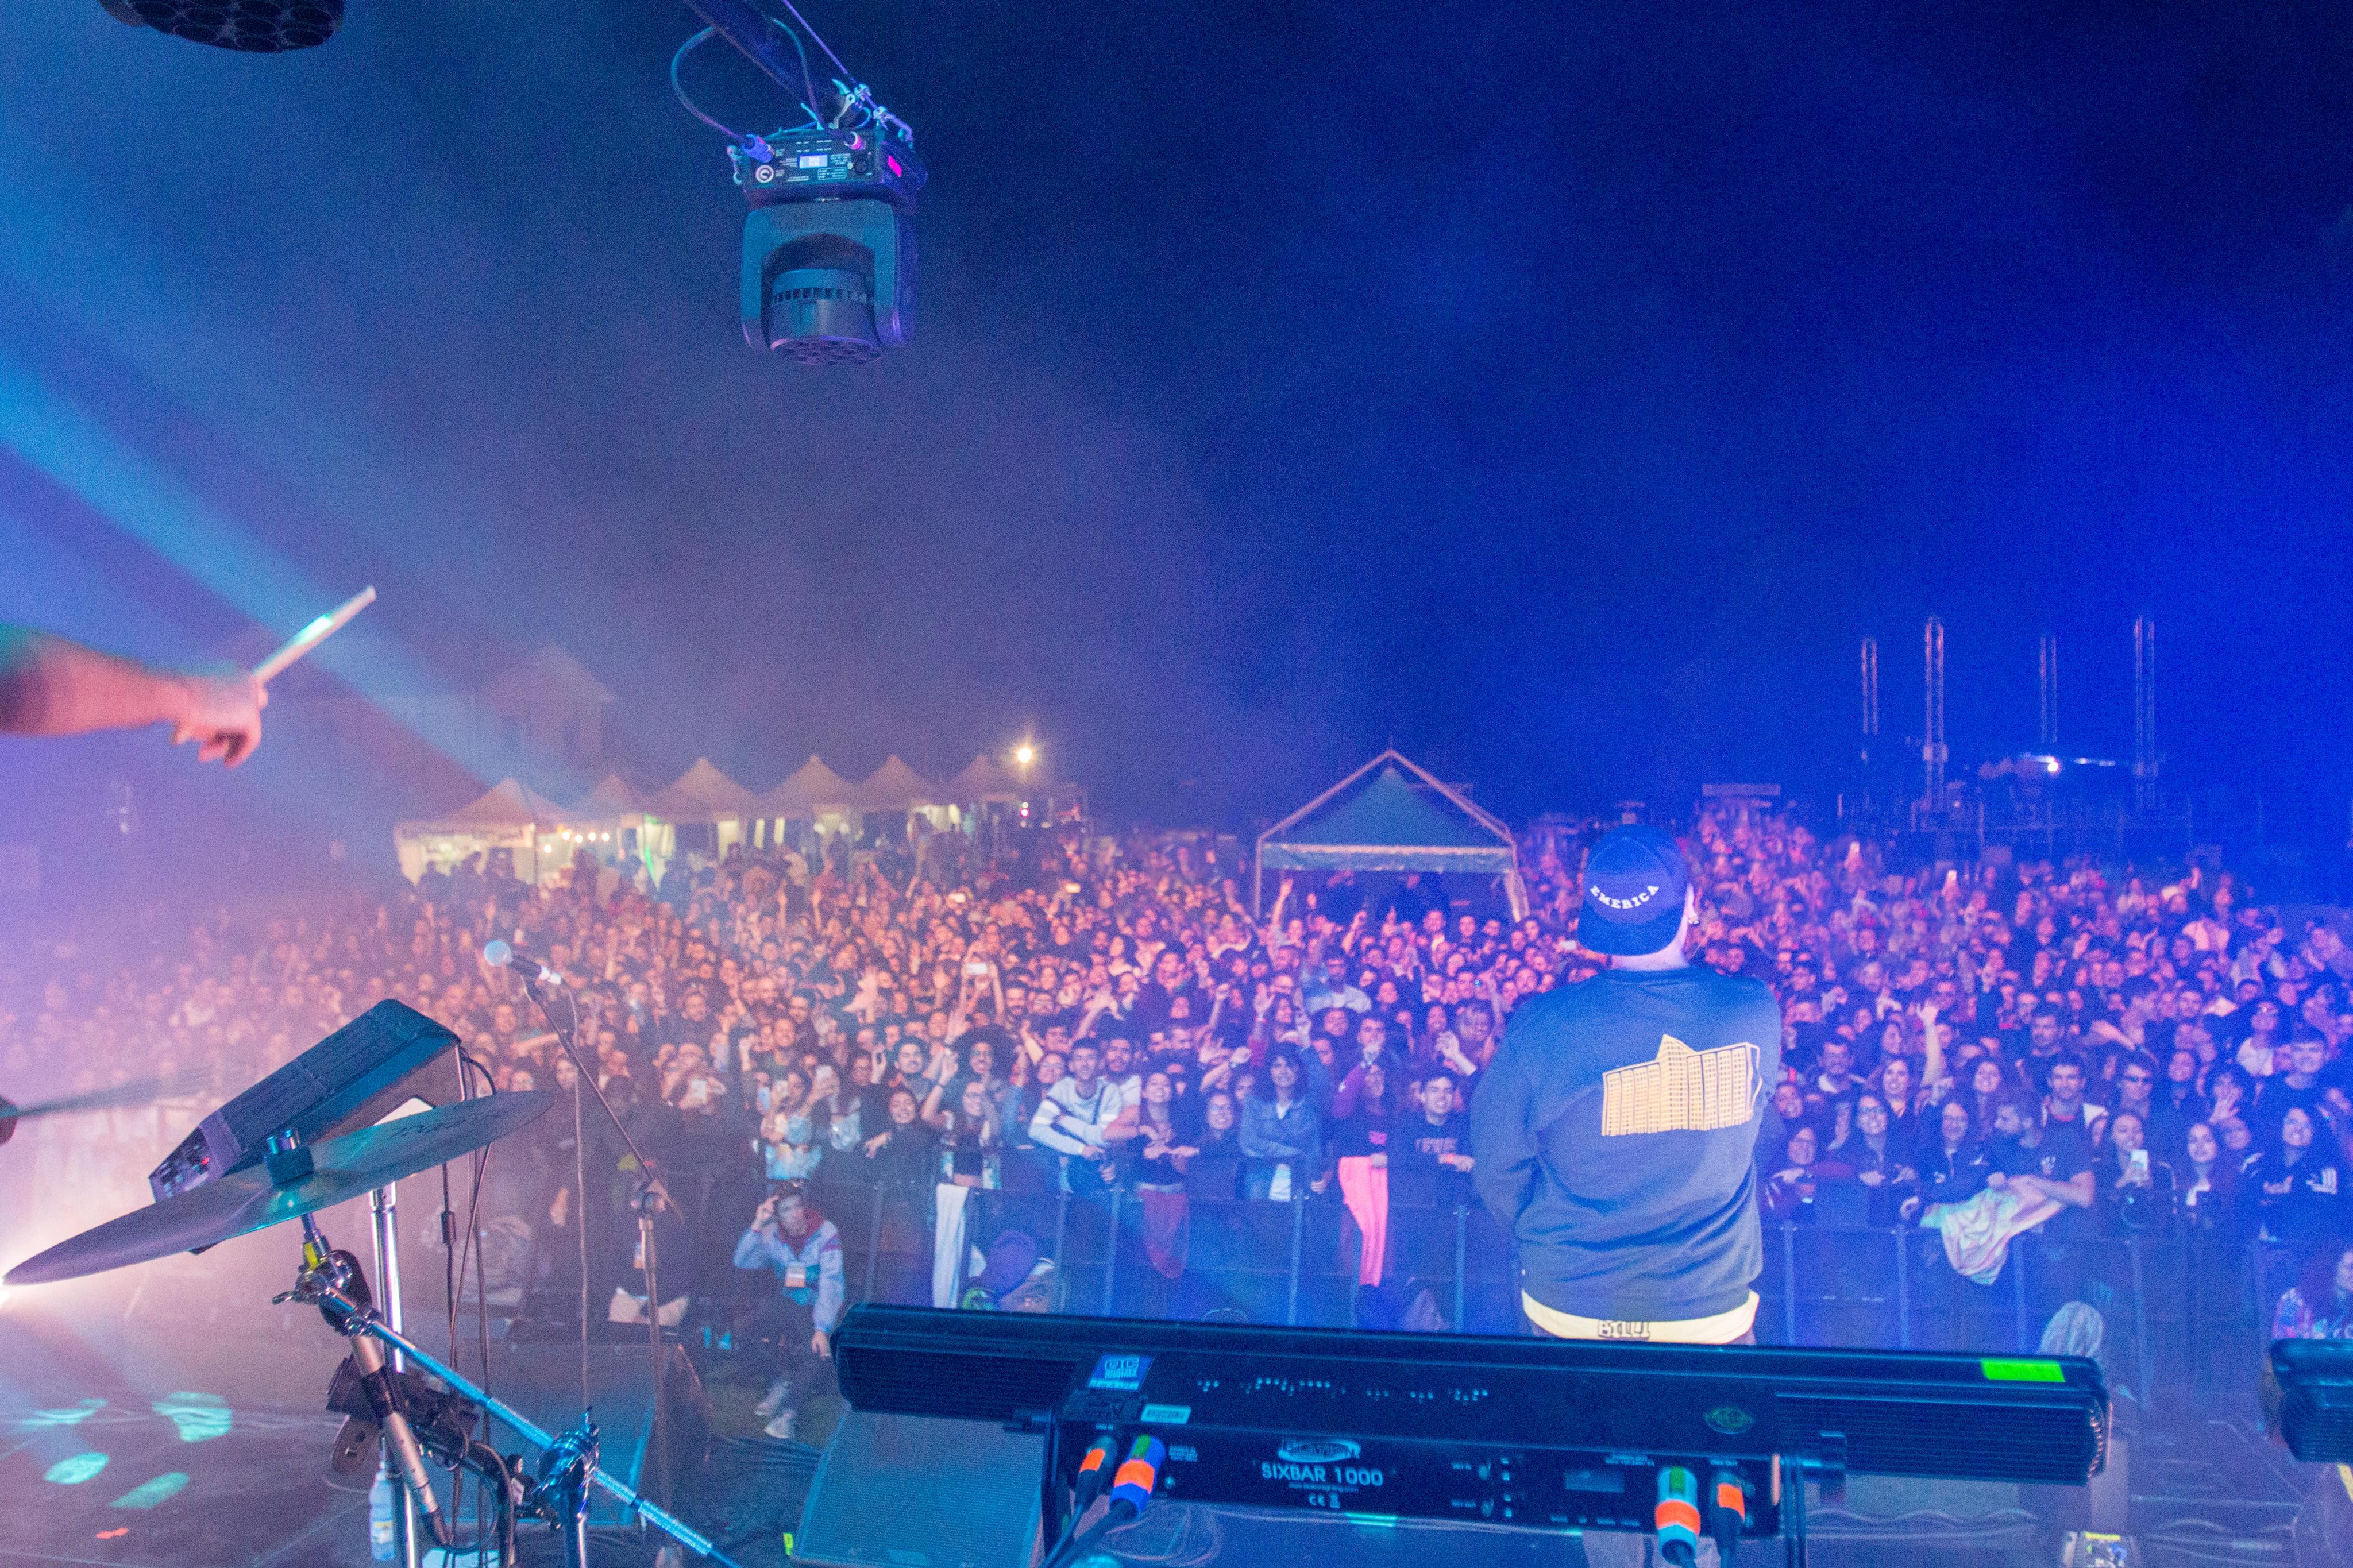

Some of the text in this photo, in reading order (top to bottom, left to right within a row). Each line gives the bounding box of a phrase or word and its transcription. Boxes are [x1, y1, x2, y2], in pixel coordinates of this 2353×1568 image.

[1590, 885, 1659, 909] EMERICA
[1262, 1461, 1384, 1487] SIXBAR 1000
